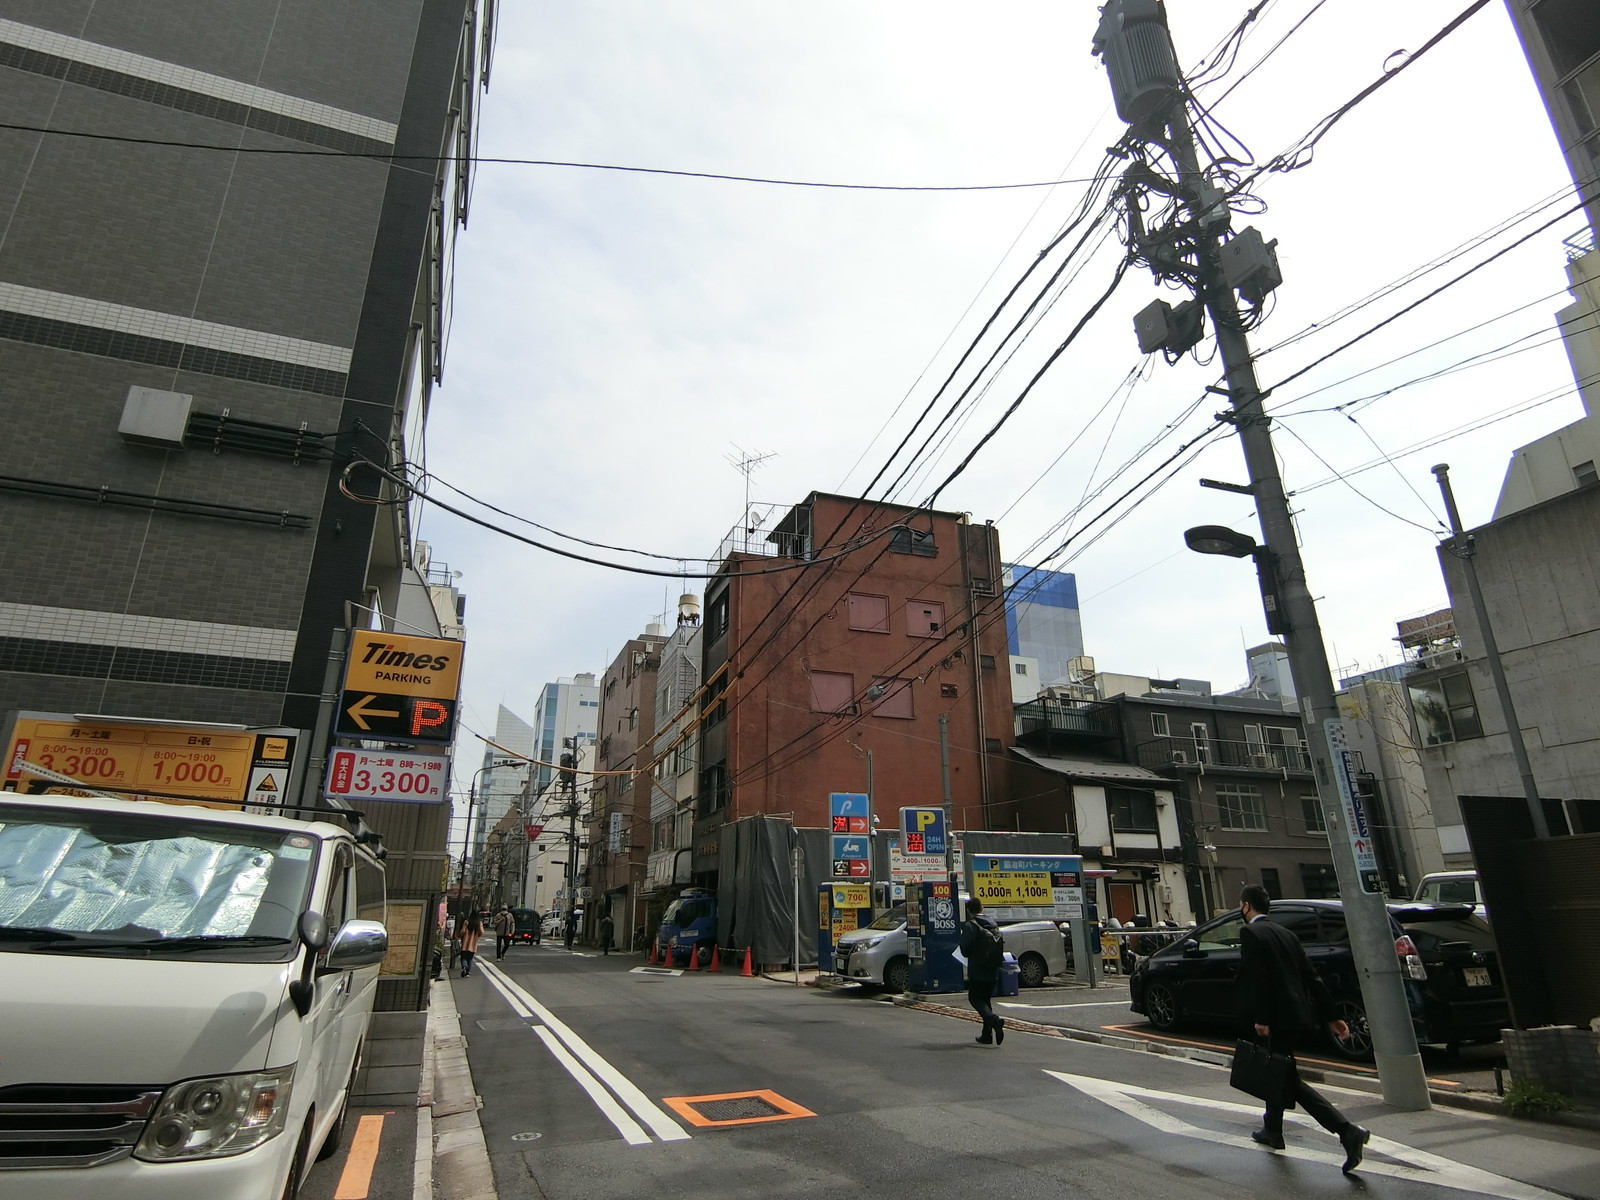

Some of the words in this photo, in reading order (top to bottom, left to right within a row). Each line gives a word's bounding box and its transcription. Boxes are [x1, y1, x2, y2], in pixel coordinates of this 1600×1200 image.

[362, 642, 449, 671] Times
[375, 671, 431, 684] PARKING
[412, 700, 448, 735] P
[354, 770, 438, 795] 3,300円
[917, 811, 936, 831] P
[990, 860, 998, 869] P
[934, 884, 949, 894] 100
[979, 887, 1012, 898] 3,000円
[1016, 887, 1048, 898] 1,100円
[934, 919, 956, 929] BOSS
